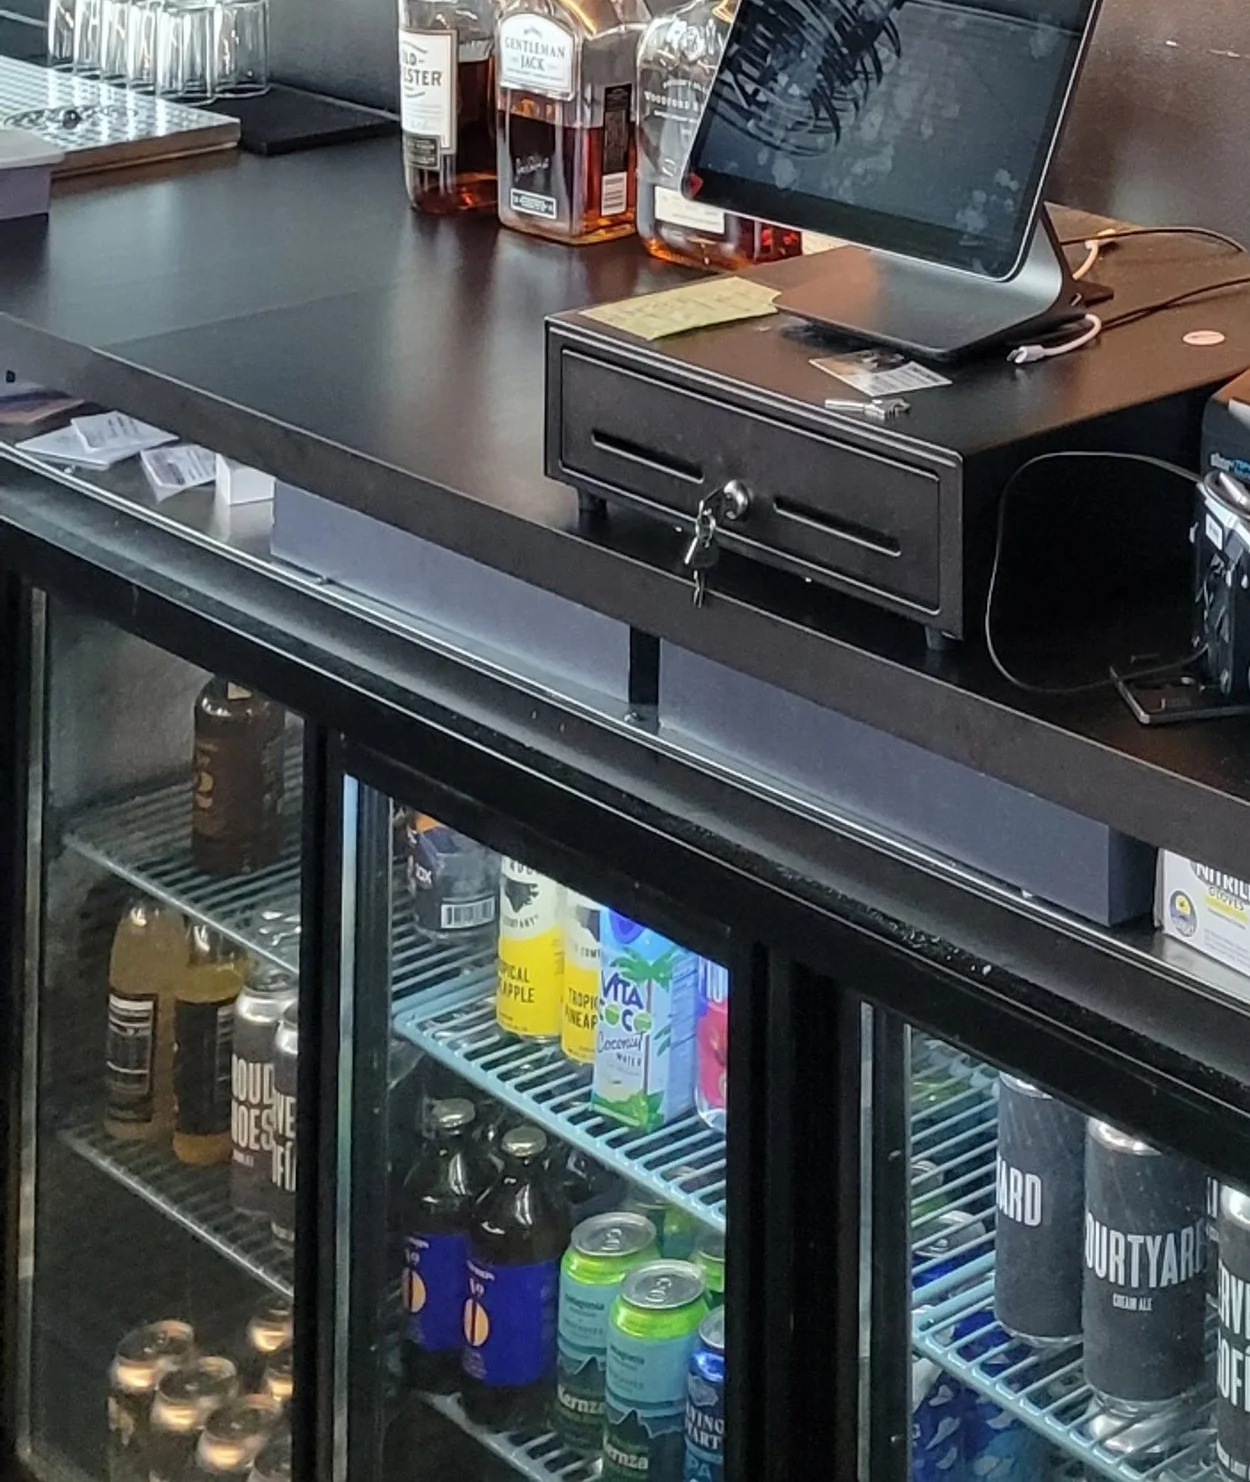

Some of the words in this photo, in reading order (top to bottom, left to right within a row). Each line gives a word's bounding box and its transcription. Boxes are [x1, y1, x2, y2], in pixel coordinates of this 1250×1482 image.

[505, 36, 565, 59] GENTLEMAN
[521, 54, 545, 71] JACK
[600, 968, 645, 1010] VITA
[616, 1053, 642, 1067] WATER
[1112, 1292, 1137, 1311] CREAM
[1138, 1295, 1153, 1312] ALE
